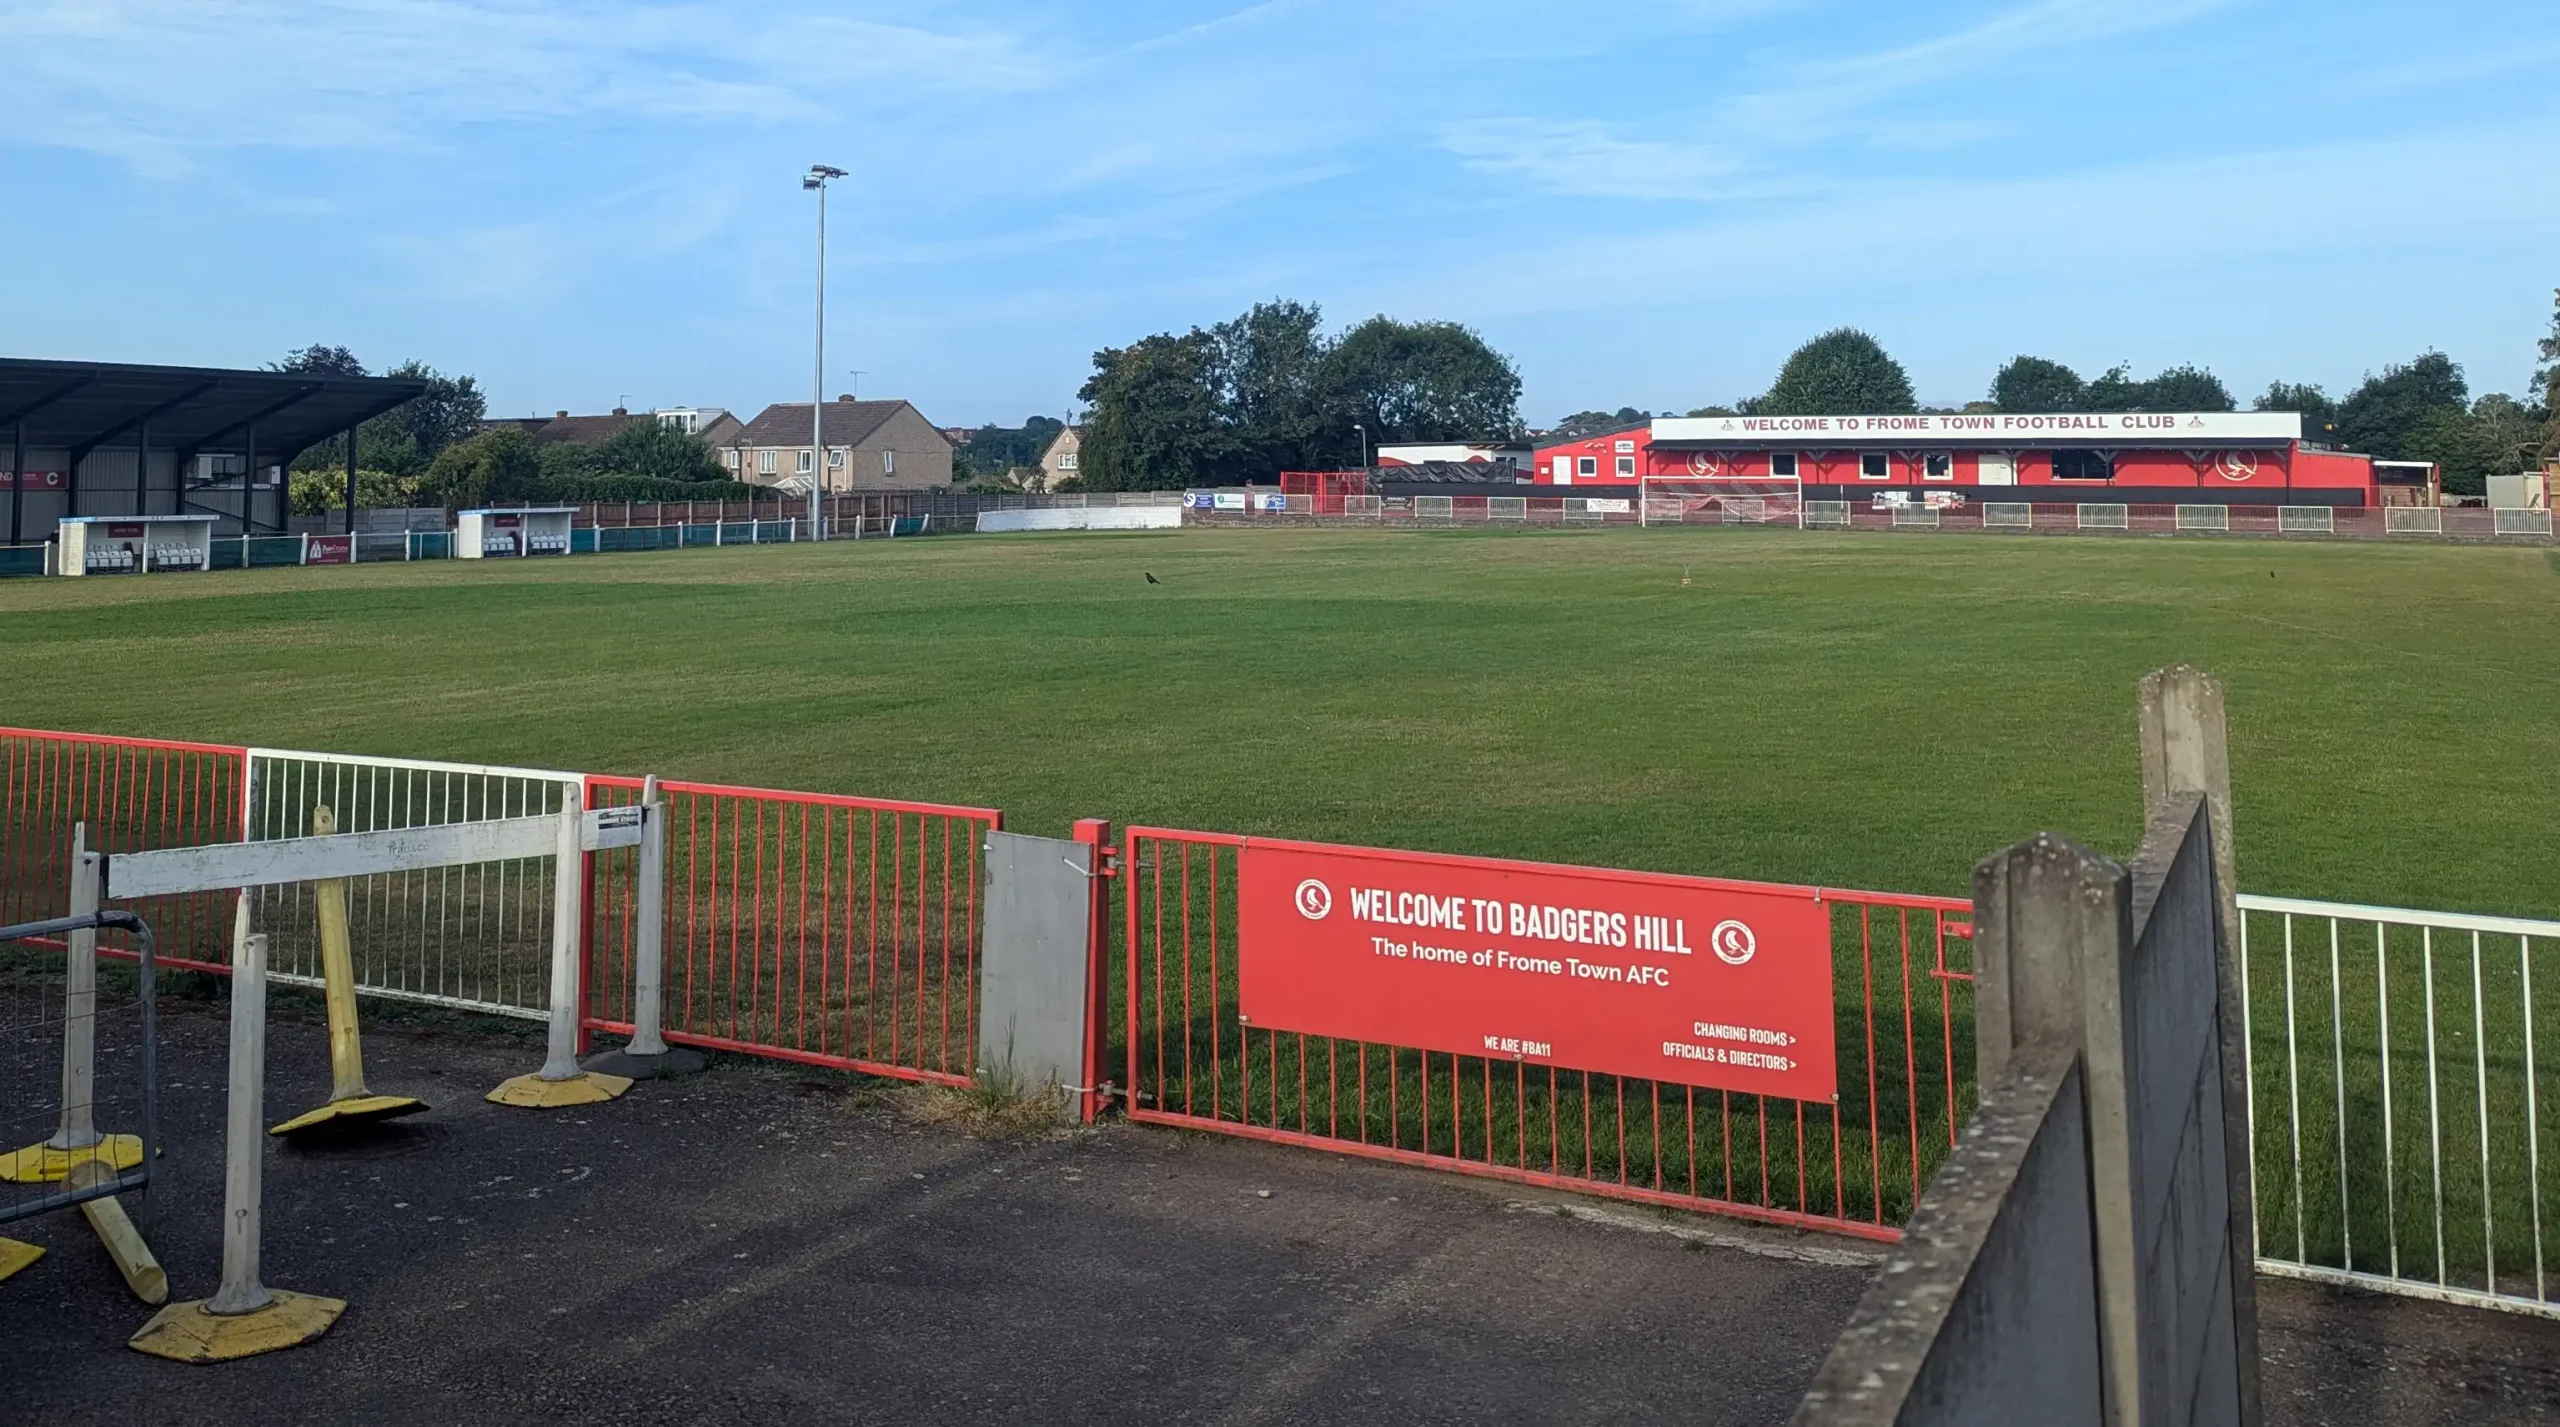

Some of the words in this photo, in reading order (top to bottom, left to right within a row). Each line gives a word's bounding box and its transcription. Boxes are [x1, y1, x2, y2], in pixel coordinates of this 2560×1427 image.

[1743, 418, 1829, 431] WELCOME
[1836, 417, 1859, 430] TO
[1866, 417, 1930, 430] FROME
[1940, 417, 1995, 430] TOWN
[2004, 416, 2109, 429] FOOTBALL
[2121, 415, 2175, 429] CLUB
[1350, 887, 1466, 931] WELCOME
[1471, 898, 1503, 935] TO
[1509, 902, 1627, 948] BADGERS
[1634, 914, 1692, 954] HILL
[1371, 936, 1408, 958] The
[1412, 940, 1468, 965] home
[1472, 949, 1493, 967] of
[1497, 950, 1563, 975] Frome
[1565, 957, 1622, 982] Town
[1626, 964, 1670, 987] AFC
[1484, 1035, 1499, 1050] WE
[1500, 1037, 1520, 1053] ARE
[1522, 1040, 1551, 1057] #BA11
[1694, 1021, 1747, 1042] CHANGING
[1749, 1028, 1787, 1046] ROOMS
[1662, 1041, 1715, 1062] OFFICIALS
[1717, 1048, 1727, 1063] &
[1729, 1050, 1788, 1071] DIRECTORS
